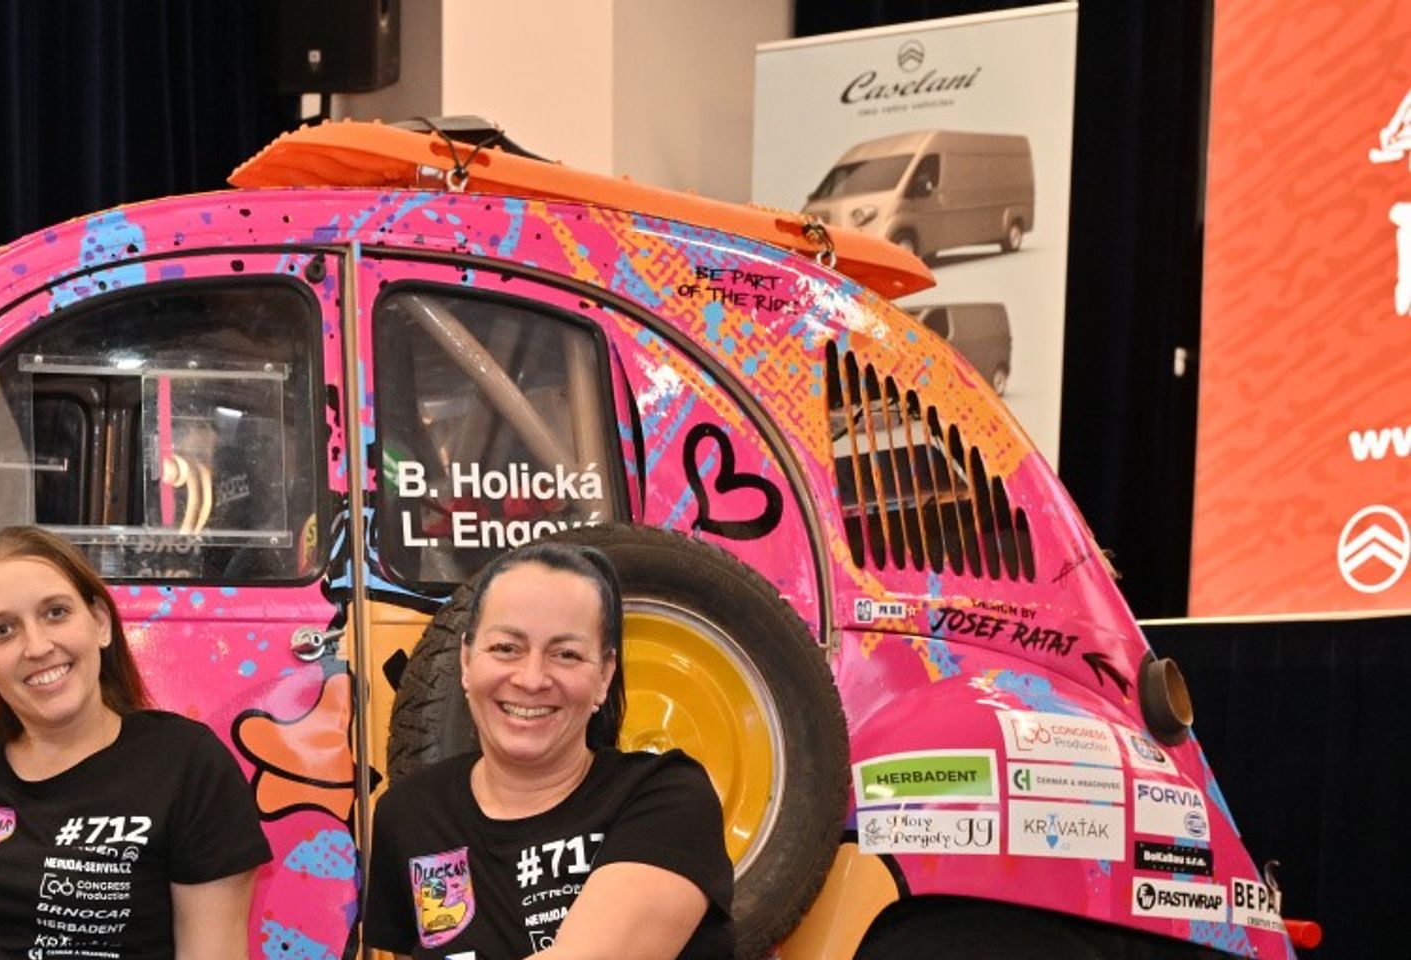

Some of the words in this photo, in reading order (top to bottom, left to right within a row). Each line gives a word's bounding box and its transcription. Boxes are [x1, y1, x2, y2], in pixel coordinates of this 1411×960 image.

[696, 266, 723, 282] BE
[733, 270, 781, 291] PART
[678, 284, 700, 298] OF
[706, 287, 749, 306] THE
[398, 461, 439, 498] B.
[452, 462, 603, 500] Holická
[402, 511, 439, 547] L.
[452, 511, 600, 550] Engo
[931, 606, 1009, 639] JOSEF
[1011, 622, 1079, 657] RATAJ
[876, 770, 978, 785] HERBADENT
[1137, 783, 1203, 809] FORVIA
[55, 816, 152, 846] #712
[76, 880, 131, 891] CONGRESS
[1234, 881, 1255, 910] BE
[36, 902, 131, 919] BRNOCAR
[1158, 890, 1223, 911] FASTWRAP
[36, 917, 126, 935] HERBADENT
[525, 906, 569, 927] NERUDA
